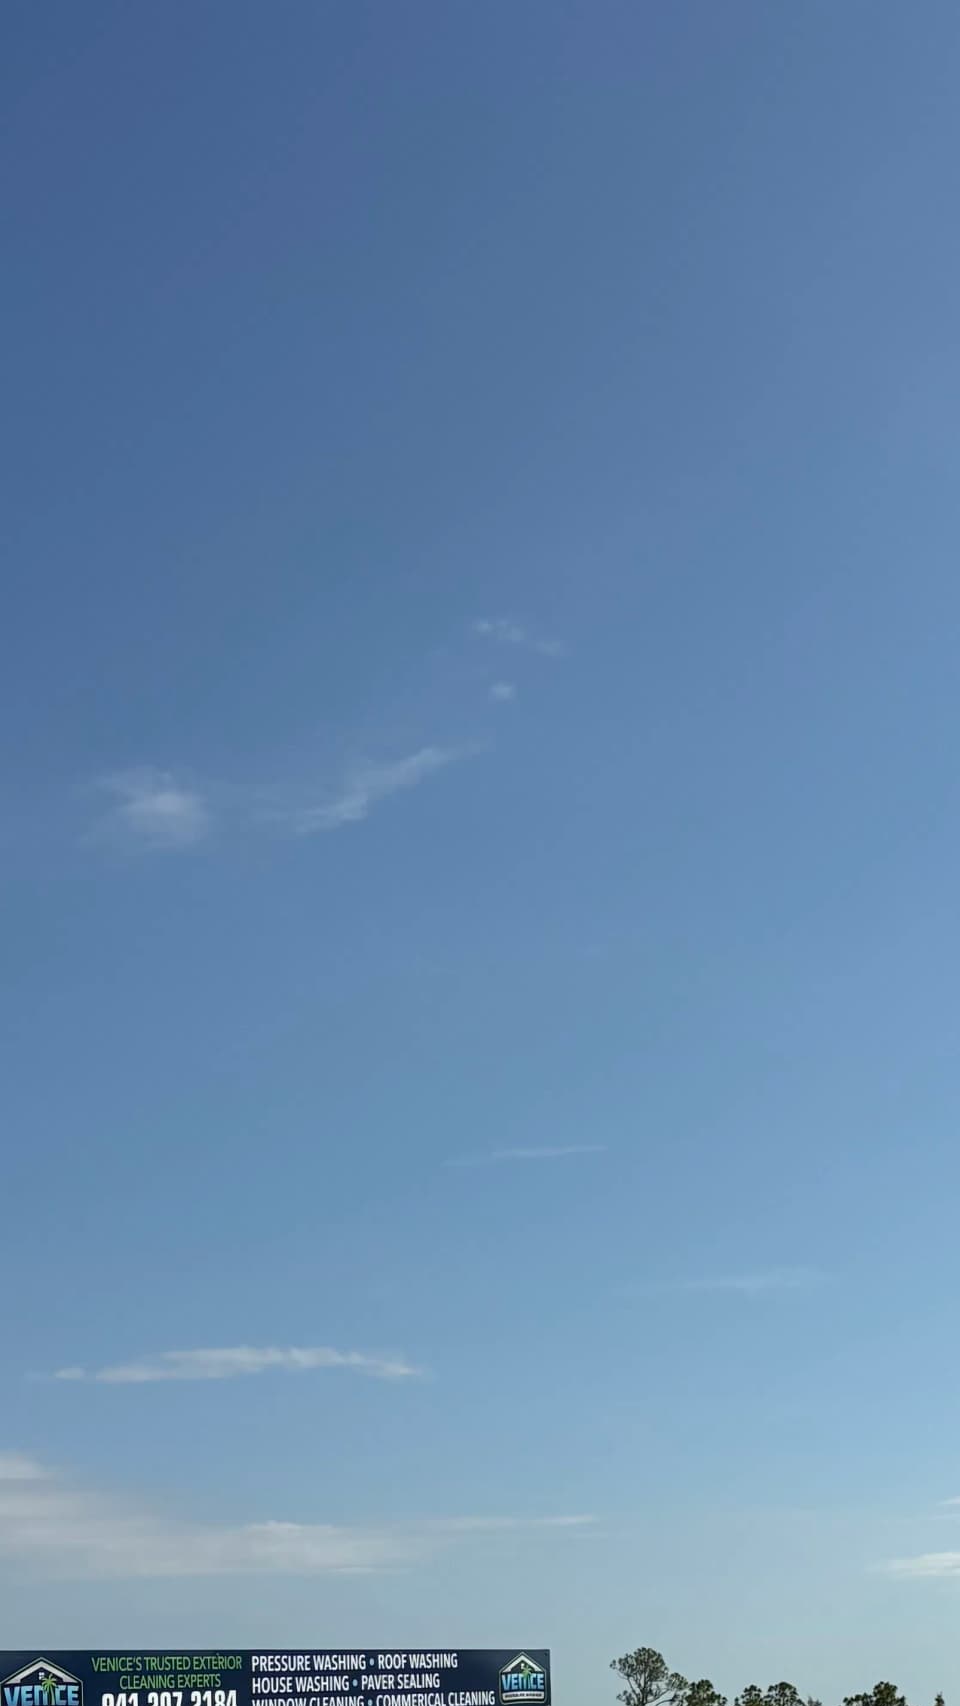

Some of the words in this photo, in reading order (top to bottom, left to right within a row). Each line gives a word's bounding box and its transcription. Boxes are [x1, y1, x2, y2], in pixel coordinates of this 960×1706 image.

[91, 1656, 142, 1672] VENICE'S
[144, 1656, 191, 1671] TRUSTED
[193, 1655, 242, 1670] EXTERIOR
[252, 1655, 311, 1672] PRESSURE
[313, 1654, 367, 1671] WASHING
[378, 1654, 407, 1669] ROOF
[408, 1653, 458, 1669] WASHING
[120, 1674, 175, 1690] CLEANING
[177, 1673, 222, 1688] EXPERTS
[252, 1676, 293, 1694] HOUSE
[295, 1675, 350, 1693] WASHING
[361, 1674, 395, 1690] PAVER
[397, 1673, 440, 1689] SEALING
[502, 1673, 545, 1691] VENICE
[448, 1690, 496, 1706] CLEANING
